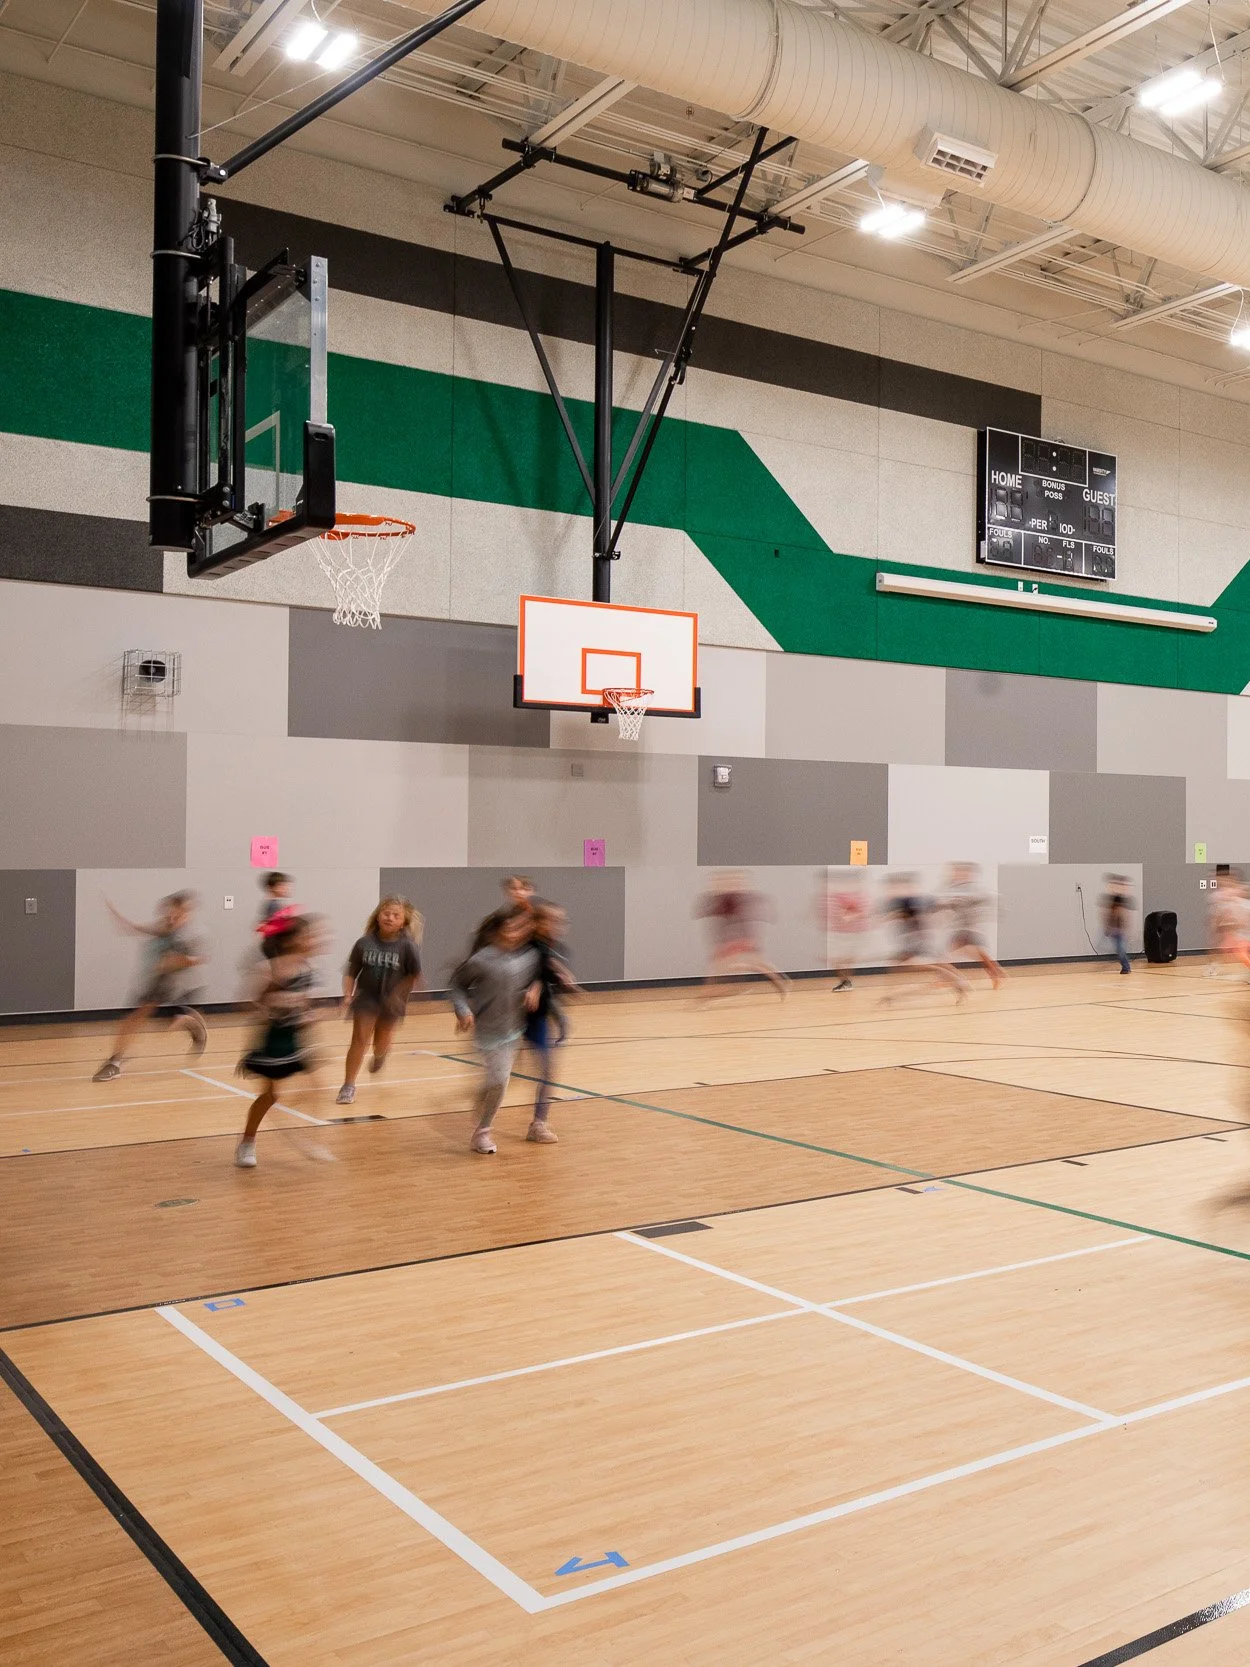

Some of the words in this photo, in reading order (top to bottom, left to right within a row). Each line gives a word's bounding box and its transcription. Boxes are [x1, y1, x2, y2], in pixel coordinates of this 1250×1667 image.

[991, 470, 1022, 489] HOME
[1042, 479, 1066, 491] BONUS
[1044, 490, 1063, 500] POSS
[1083, 488, 1115, 506] GUEST
[989, 528, 1013, 538] FOULS
[1038, 536, 1051, 545] NO.
[1062, 540, 1075, 549] FLS
[1093, 545, 1114, 555] FOULS
